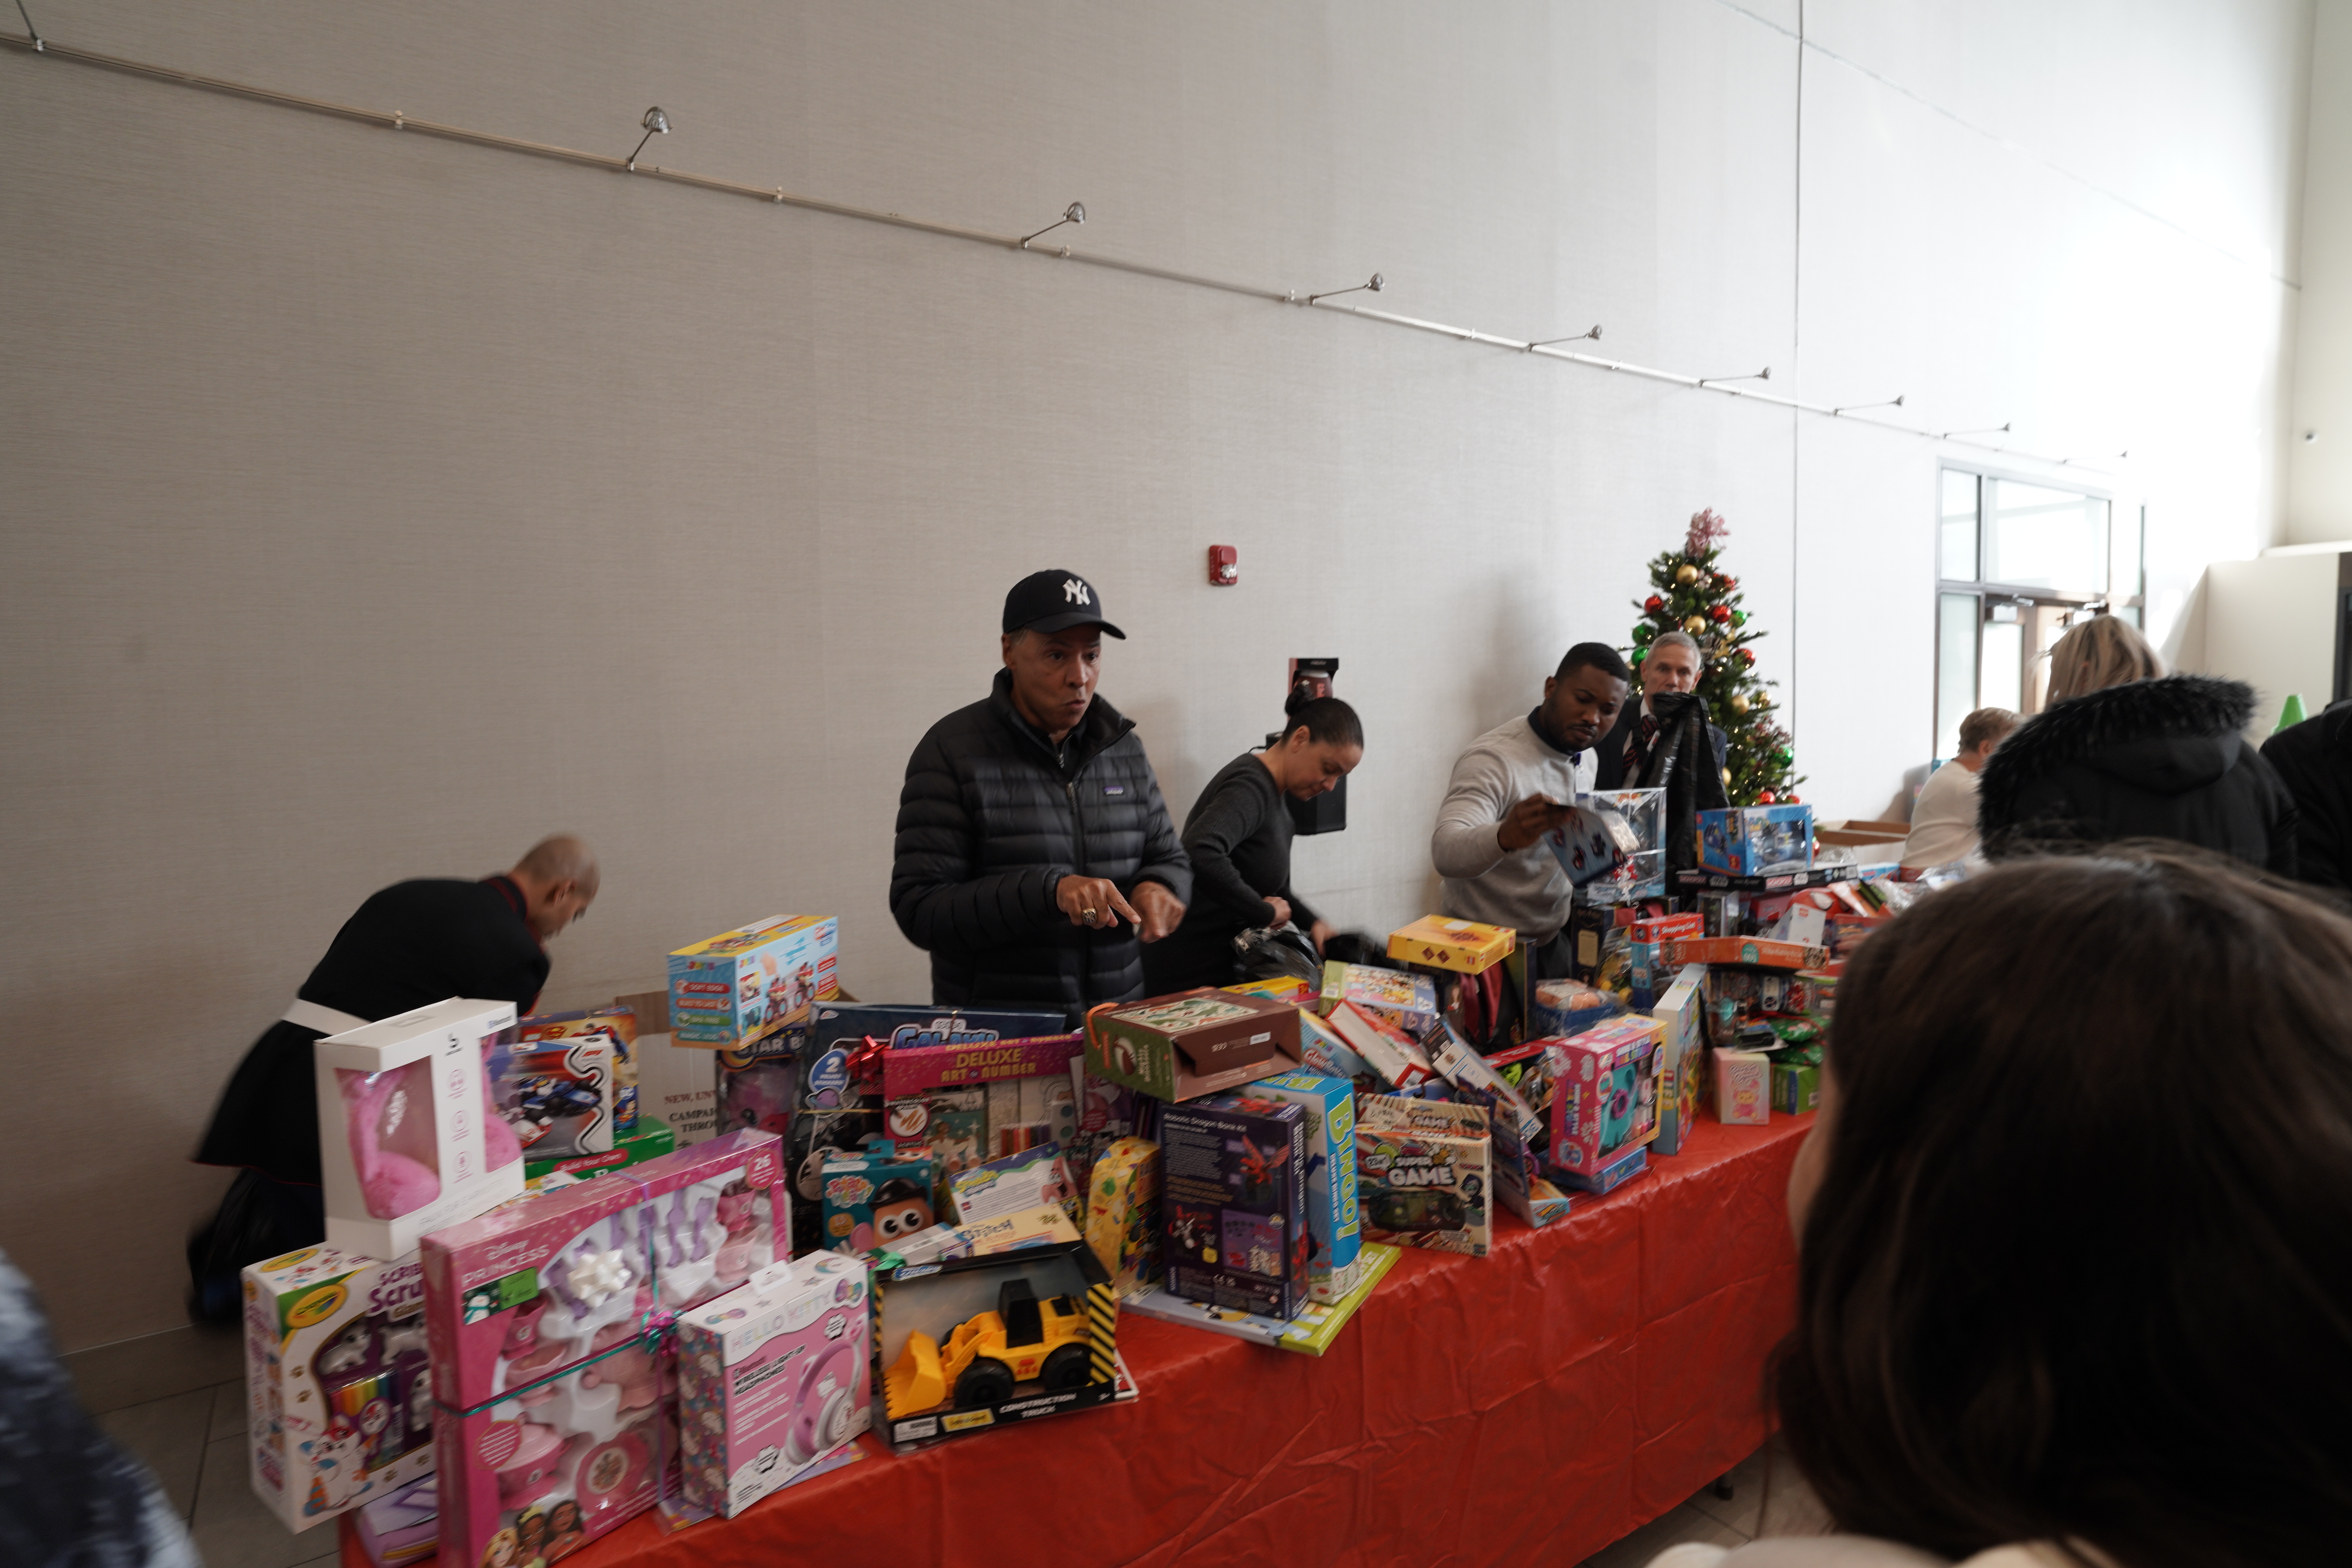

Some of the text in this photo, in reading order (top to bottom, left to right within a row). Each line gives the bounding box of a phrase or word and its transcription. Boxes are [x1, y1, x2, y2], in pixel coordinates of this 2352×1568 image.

[945, 1041, 997, 1051] DELUXE
[825, 1057, 841, 1073] 2
[956, 1049, 1022, 1068] DELUXE
[941, 1068, 967, 1082] ART
[981, 1062, 1036, 1079] NUMBER
[681, 1118, 716, 1132] THRO
[1164, 1112, 1190, 1124] Robotic
[1191, 1117, 1217, 1128] Dragon
[1217, 1121, 1237, 1130] Bank
[1237, 1124, 1247, 1132] Kit
[560, 1152, 623, 1171] Build Your Own
[1328, 1092, 1360, 1241] BINGO!
[1388, 1167, 1454, 1187] GAME
[461, 1244, 551, 1288] PRINCESS
[367, 1277, 425, 1313] Scru
[730, 1289, 831, 1354] HELLO KITTY
[999, 1393, 1076, 1414] CONSTRUCTION
[1021, 1405, 1056, 1418] TRUCK
